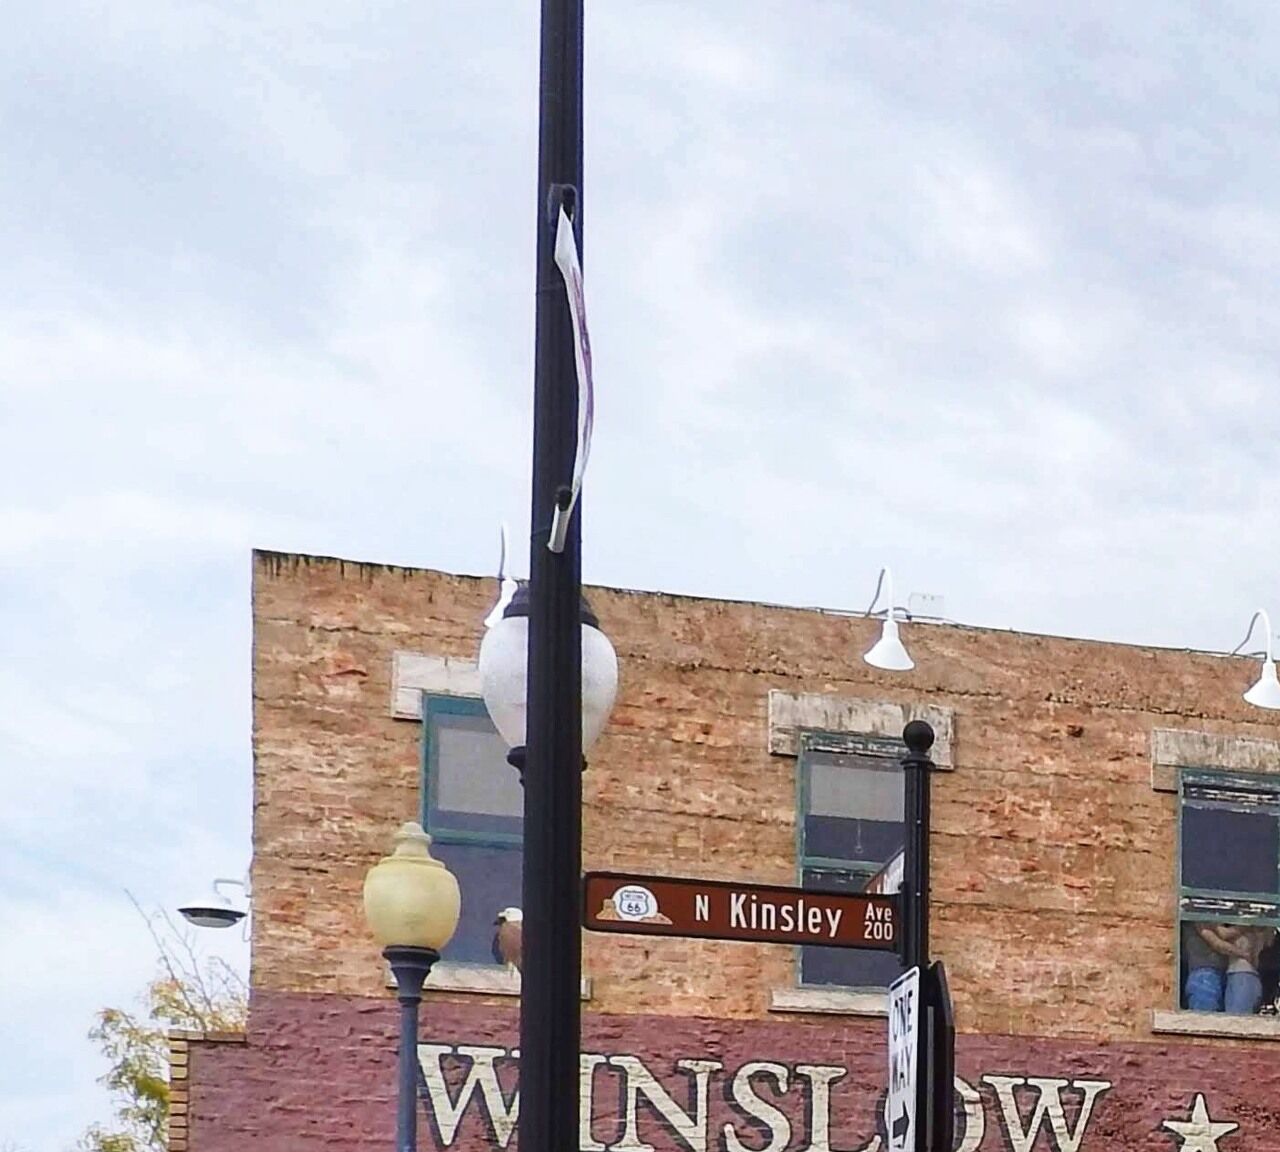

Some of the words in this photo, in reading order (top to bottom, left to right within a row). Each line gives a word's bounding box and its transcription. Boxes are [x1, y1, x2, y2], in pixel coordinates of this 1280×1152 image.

[627, 903, 641, 912] 66
[695, 894, 709, 922] N
[730, 893, 843, 938] Kinsley
[865, 902, 893, 922] Ave
[863, 922, 894, 941] 200
[892, 990, 913, 1042] ONE
[892, 1043, 912, 1094] WAY
